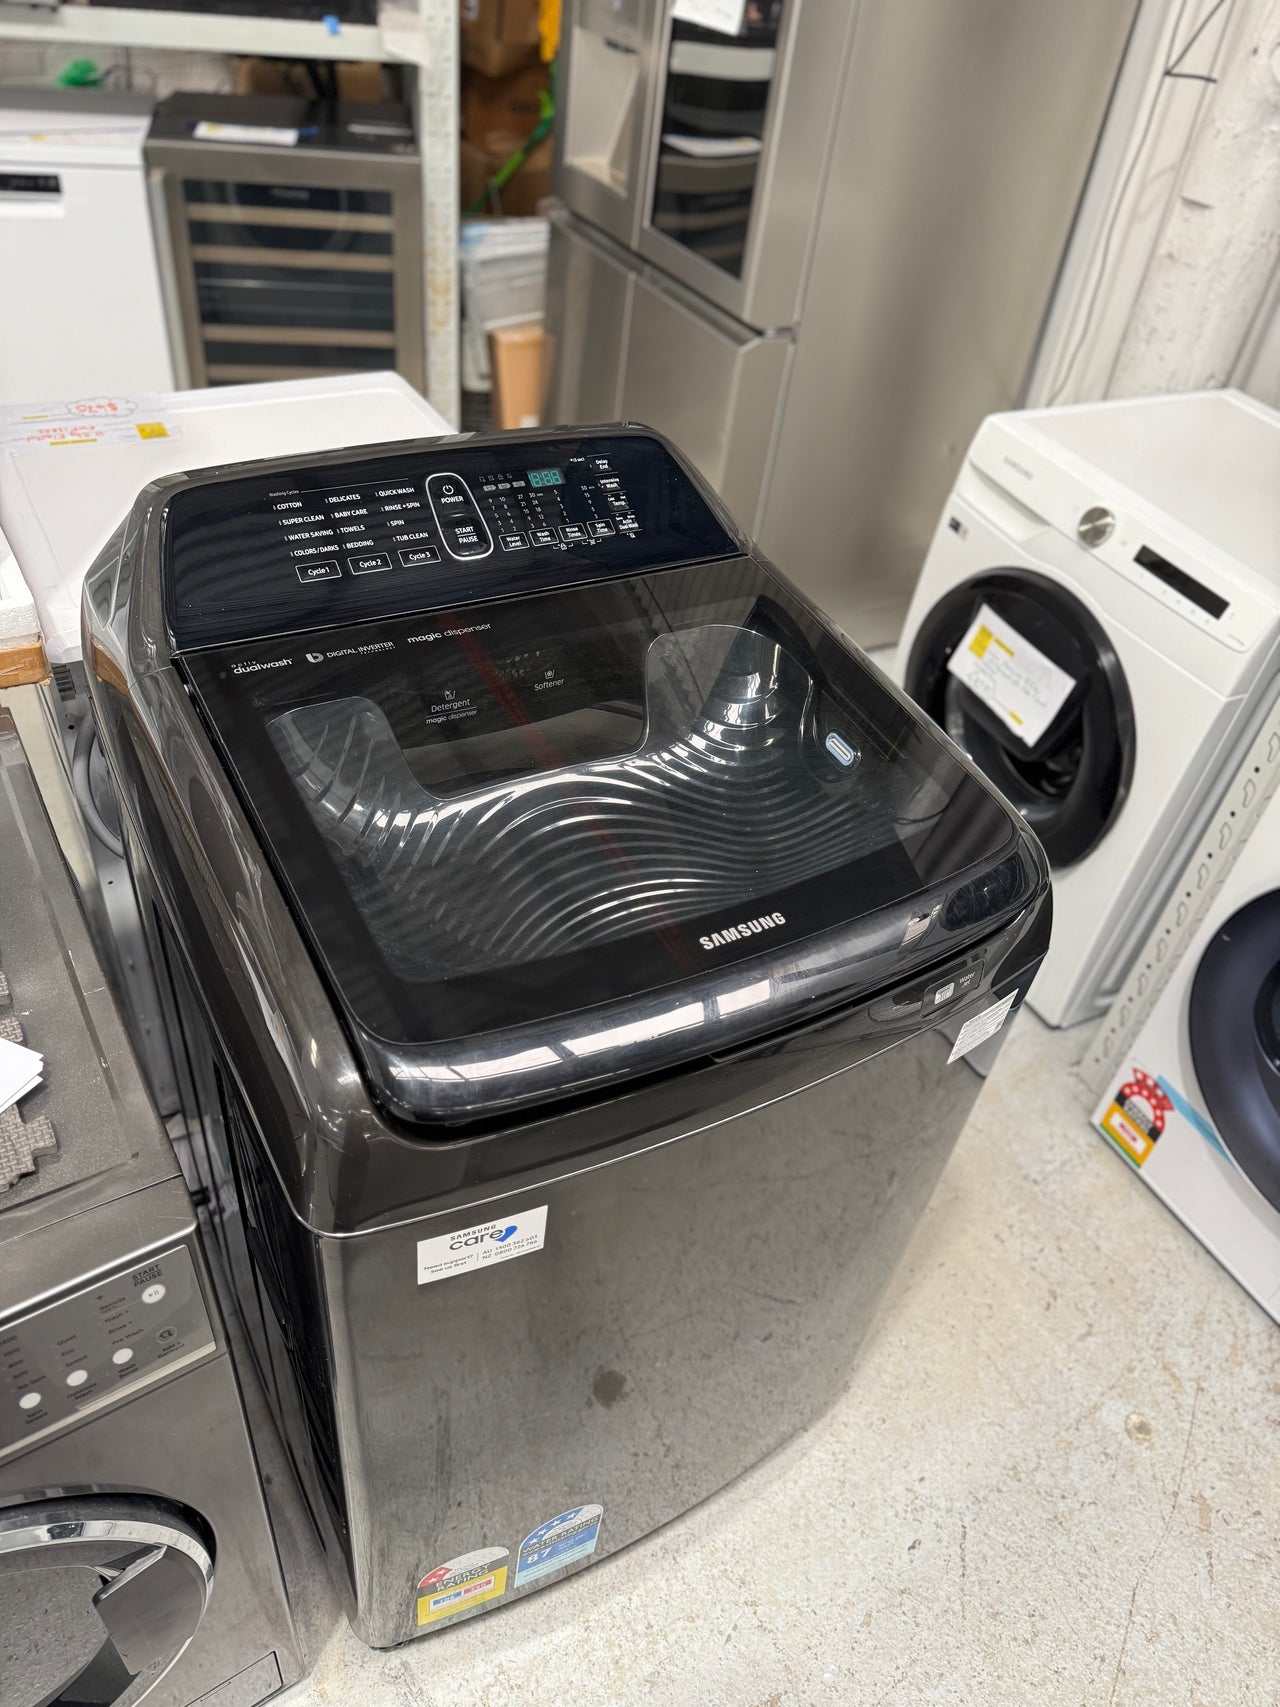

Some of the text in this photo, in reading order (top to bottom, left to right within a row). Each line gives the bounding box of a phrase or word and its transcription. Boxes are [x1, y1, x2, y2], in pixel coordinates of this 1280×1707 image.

[379, 487, 415, 497] QUICK WASH
[329, 494, 361, 503] DELICATES
[441, 495, 464, 504] POWER
[277, 501, 302, 510] COTTON
[384, 504, 402, 512] RINSE
[406, 502, 420, 510] SPIN
[351, 508, 368, 517] CARE
[282, 514, 325, 526] SUPER CLEAN
[390, 519, 405, 527] SPIN
[288, 529, 333, 541] WATER SAVING
[340, 525, 365, 534] TOWELS
[455, 526, 474, 535] START
[409, 532, 428, 540] CLEAN
[458, 535, 478, 544] PAUSE
[346, 540, 374, 549] BEDDING
[409, 552, 425, 561] Cycle
[359, 560, 377, 568] Cycle
[307, 567, 325, 576] Cycle
[407, 623, 491, 643] magic dispenser
[327, 641, 394, 658] DIGITAL INVERTER
[233, 658, 291, 674] dualwash
[534, 678, 565, 691] Softener
[431, 699, 470, 713] Detergent
[426, 709, 477, 725] magic dispenser
[699, 912, 786, 950] SAMSUNG
[960, 971, 975, 984] Water
[450, 1224, 497, 1242] SAMSUNG
[449, 1229, 504, 1250] care
[424, 1254, 474, 1271] Need support?
[132, 1264, 160, 1280] START
[134, 1269, 162, 1287] PAUSE
[522, 1535, 558, 1553] WATER
[561, 1517, 598, 1536] RATING
[527, 1547, 553, 1563] 87
[436, 1563, 490, 1587] ENERGY
[437, 1569, 489, 1592] RATING
